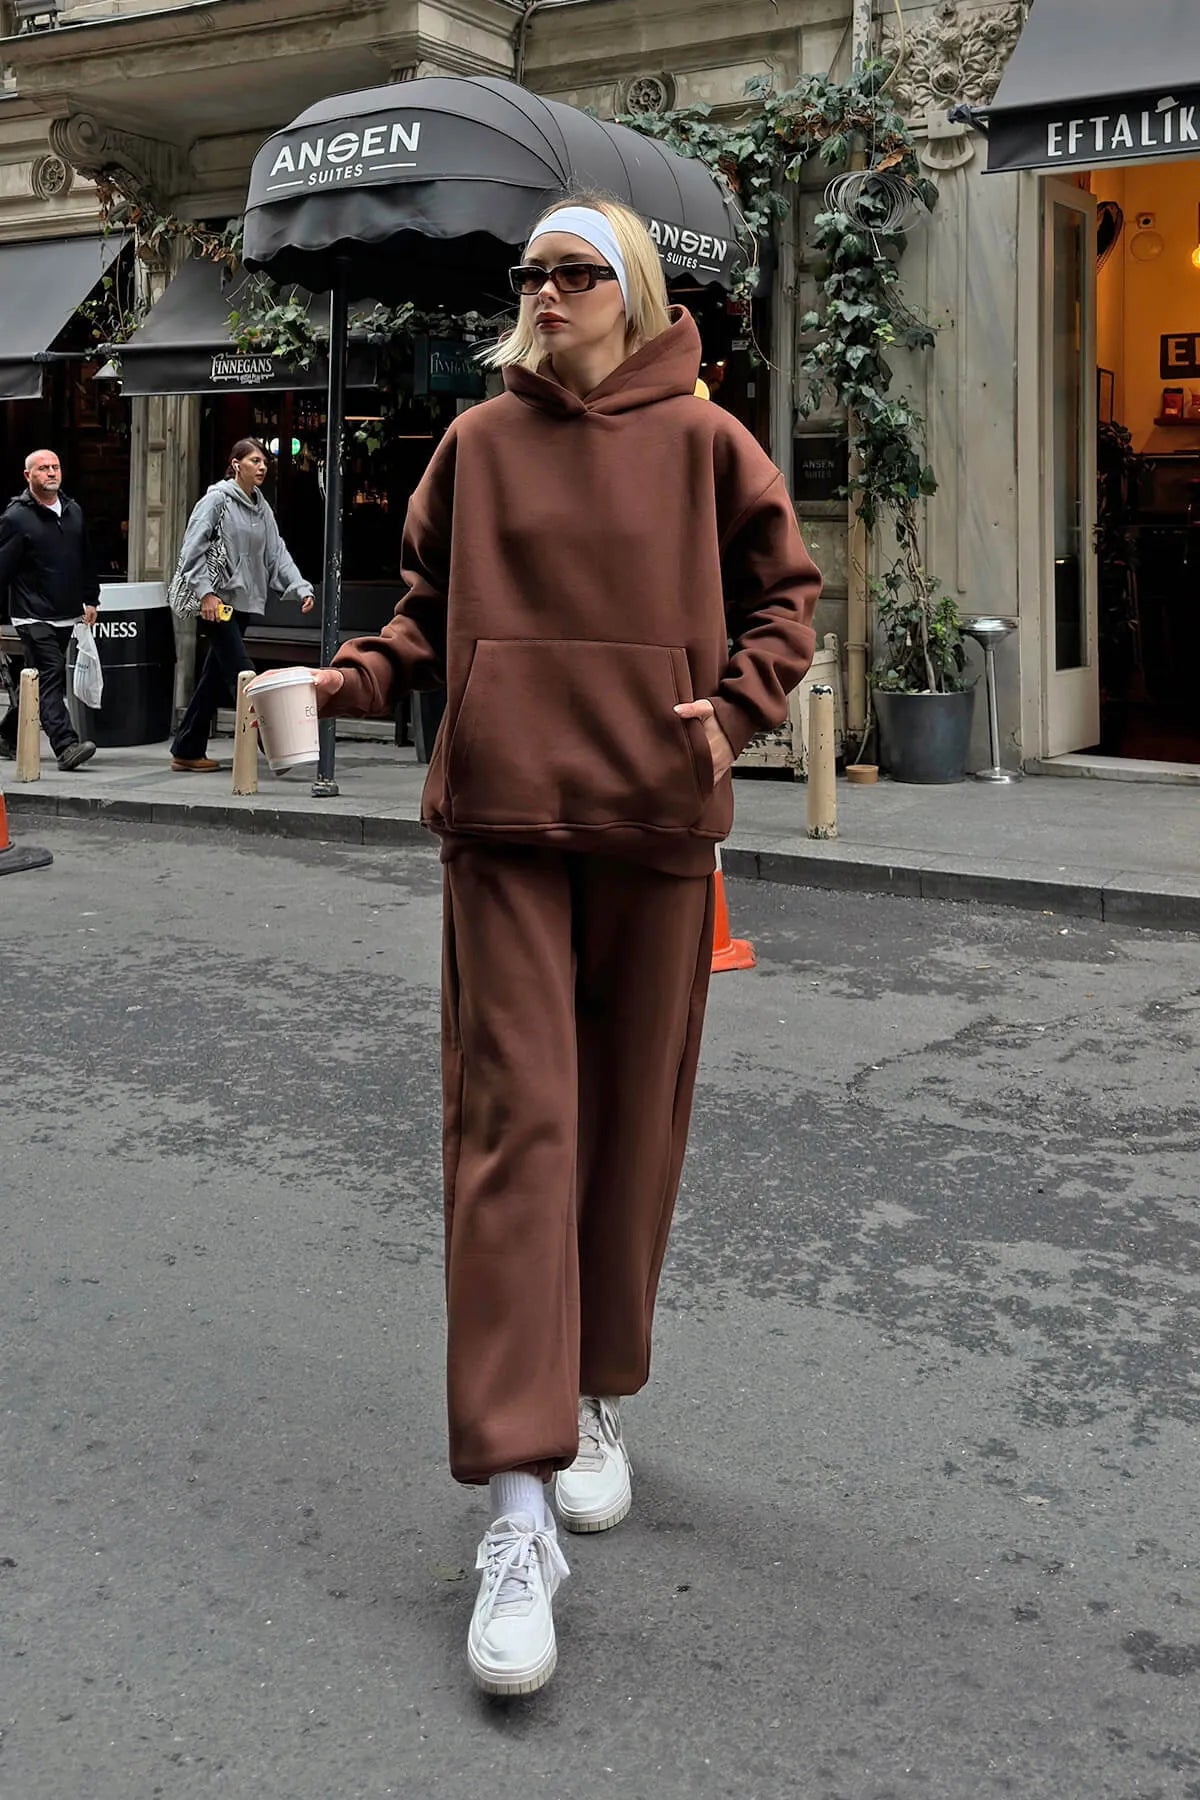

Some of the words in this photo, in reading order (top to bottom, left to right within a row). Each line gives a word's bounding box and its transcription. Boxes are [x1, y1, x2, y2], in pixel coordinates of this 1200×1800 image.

[270, 122, 420, 176] ANSEN
[308, 164, 363, 186] SUITES
[649, 220, 727, 262] ANSEN
[666, 252, 698, 269] SUITES
[1168, 337, 1200, 366] E
[211, 353, 272, 377] FINNEGANS
